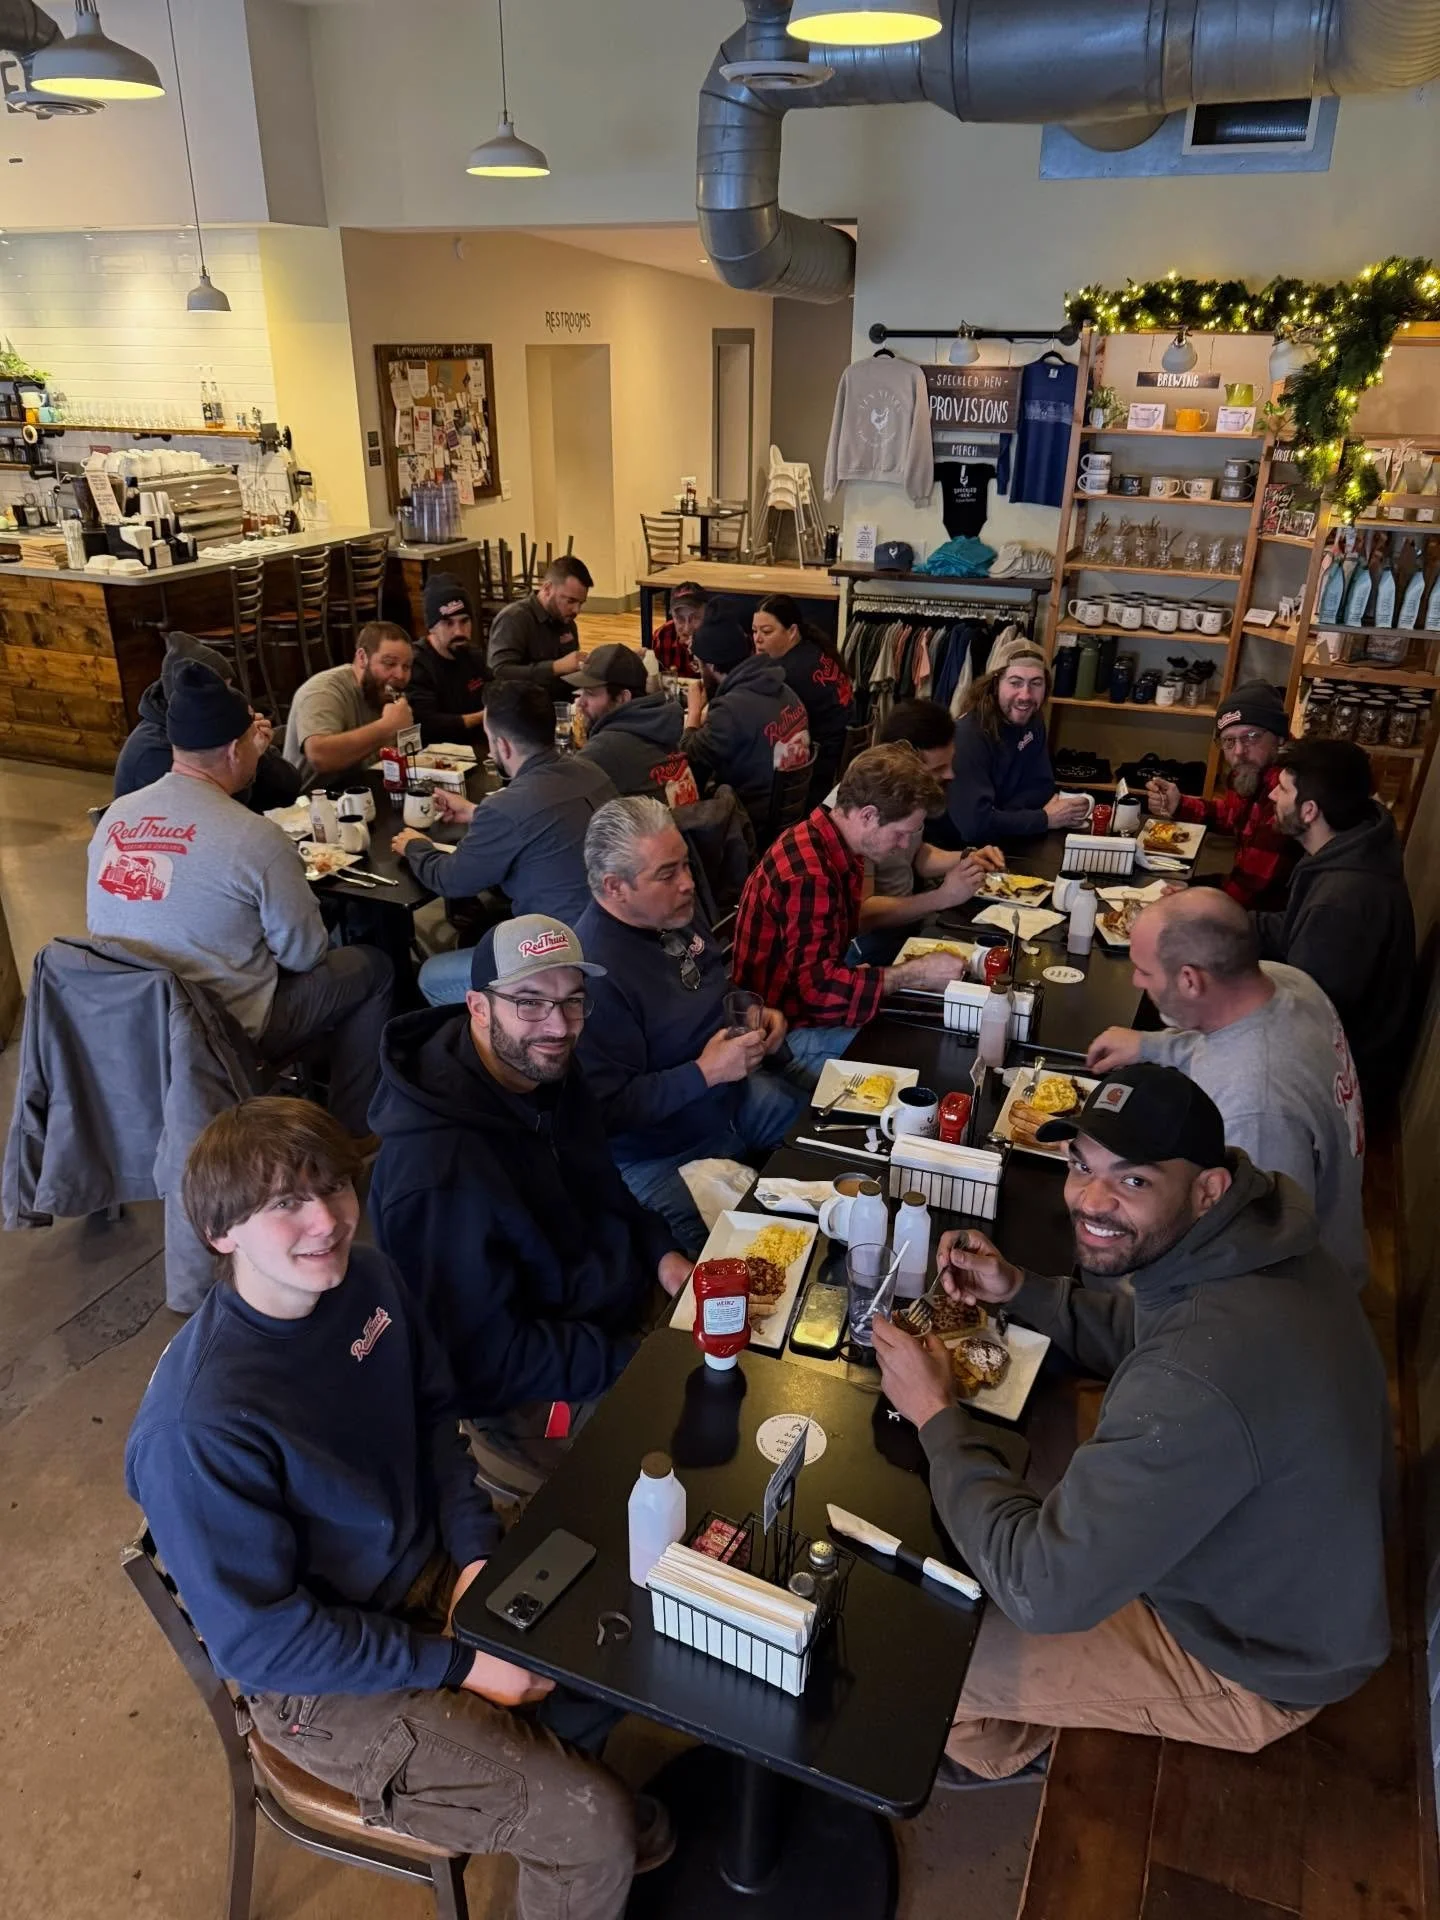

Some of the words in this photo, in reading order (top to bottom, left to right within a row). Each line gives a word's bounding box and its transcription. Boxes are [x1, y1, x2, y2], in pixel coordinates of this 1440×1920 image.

[545, 311, 591, 334] RESTROOMS
[936, 374, 979, 387] SPECKLED
[984, 375, 1002, 388] HEN
[1157, 373, 1199, 388] BREWING
[929, 395, 1009, 424] PROVISIONS
[951, 444, 978, 457] MERCH
